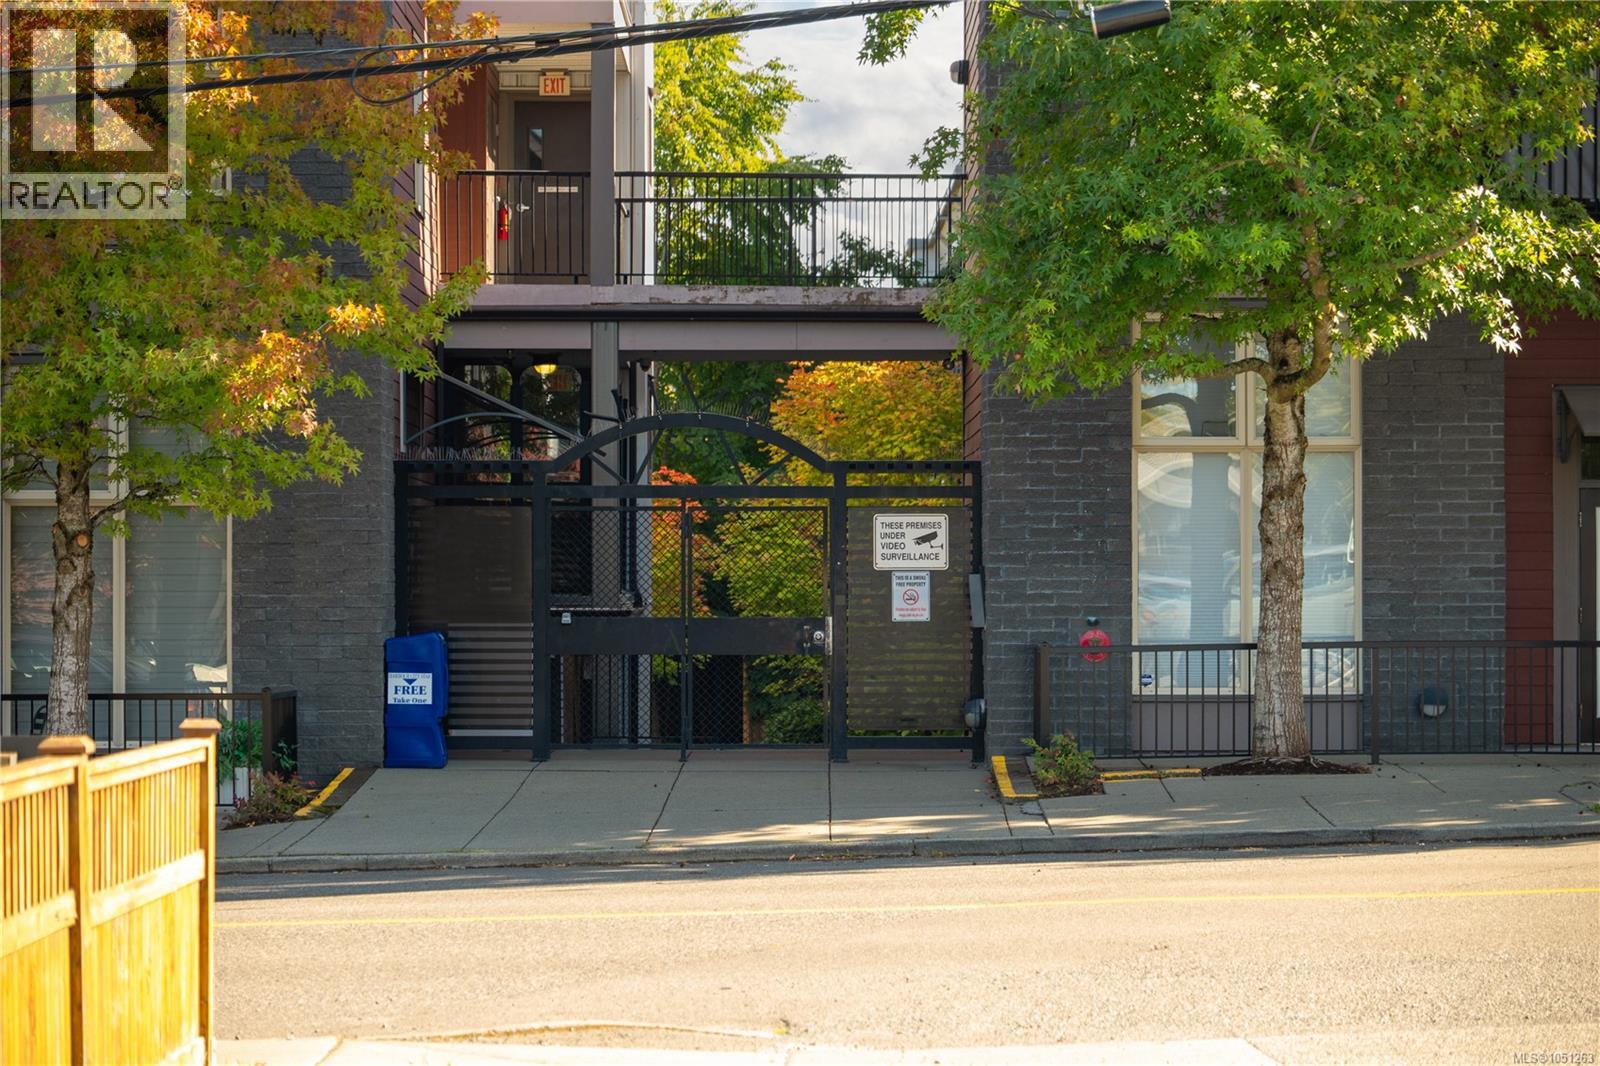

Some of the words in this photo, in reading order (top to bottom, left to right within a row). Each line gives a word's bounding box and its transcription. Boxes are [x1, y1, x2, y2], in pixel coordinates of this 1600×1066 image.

[543, 77, 566, 94] EXIT
[880, 521, 904, 529] THESE
[905, 521, 942, 529] PREMISES
[880, 542, 906, 550] VIDEO
[880, 552, 940, 560] SURVEILLANCE
[393, 685, 427, 696] FREE
